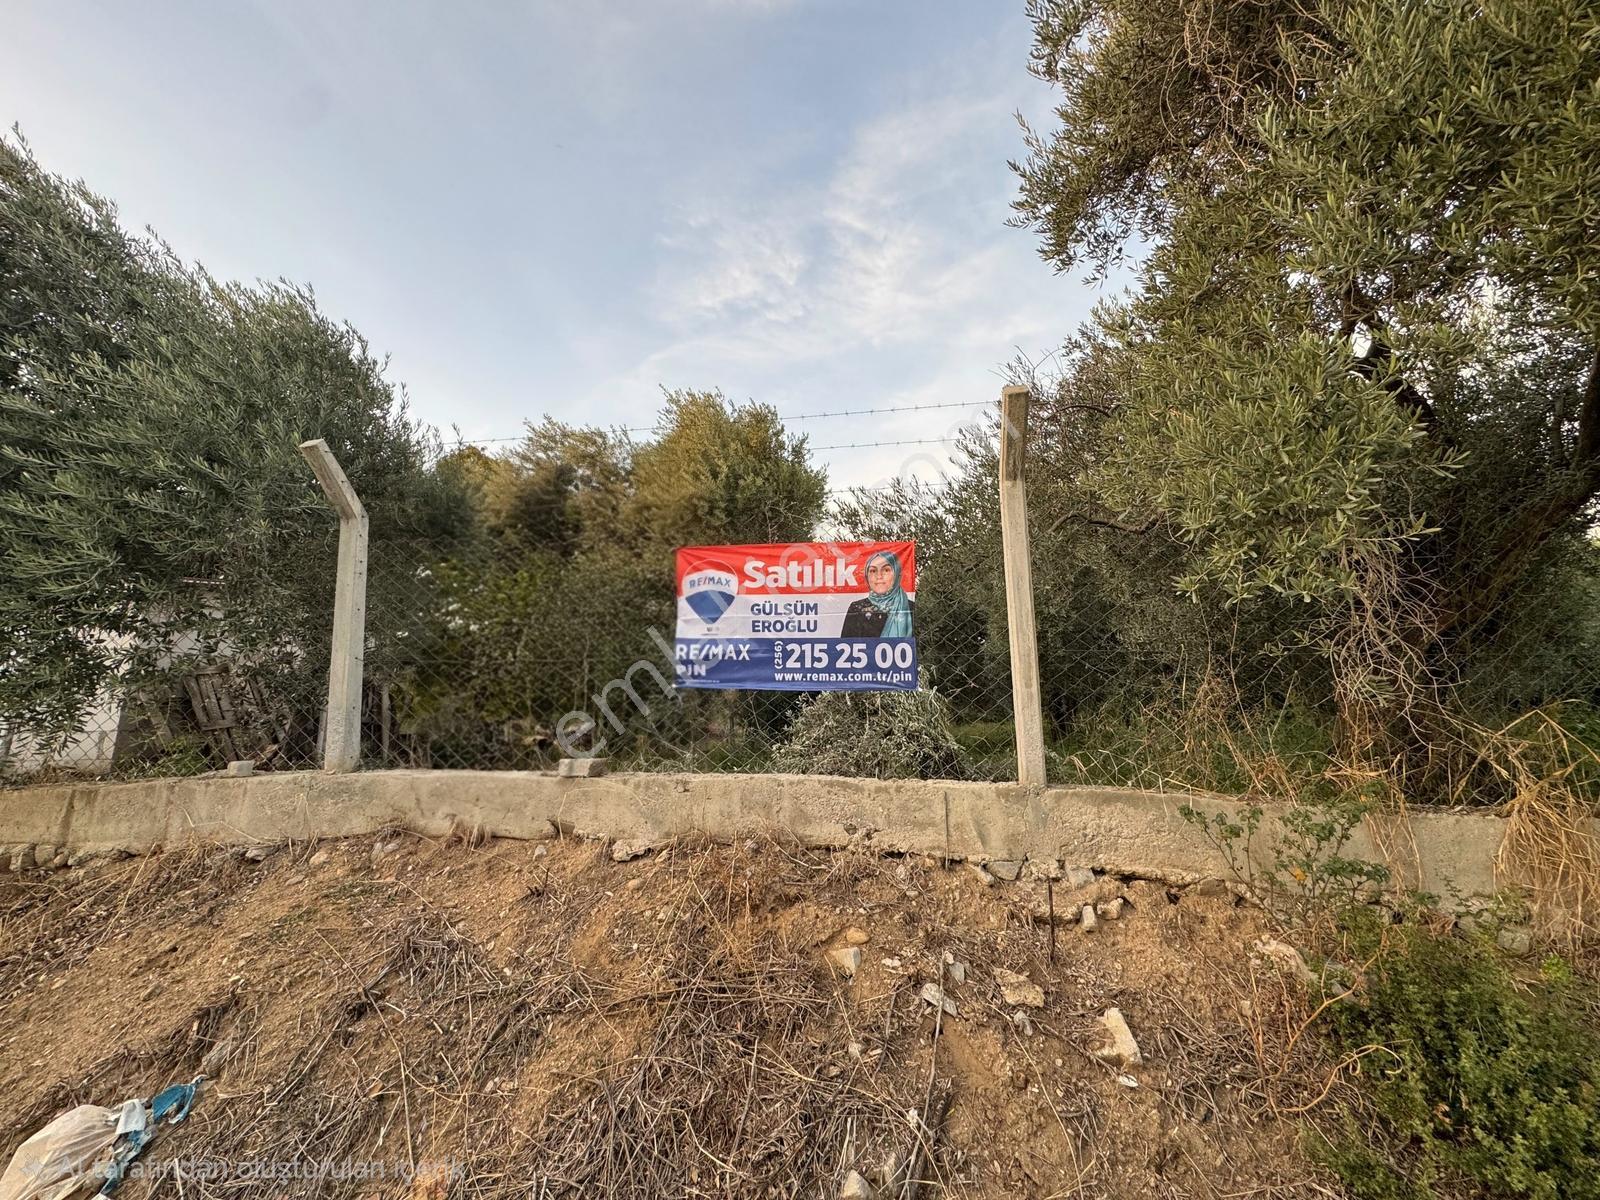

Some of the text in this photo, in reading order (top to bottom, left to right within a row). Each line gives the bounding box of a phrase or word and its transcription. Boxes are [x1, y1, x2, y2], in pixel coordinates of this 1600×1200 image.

[688, 575, 731, 589] RE/MAX
[743, 558, 858, 589] Satılık
[750, 600, 819, 616] GÜLSÜM
[751, 616, 818, 633] EROĞLU
[675, 643, 751, 661] RE/MAX
[774, 640, 913, 669] (256) 215 25 00
[774, 671, 913, 683] www.remax.com.tr/pin
